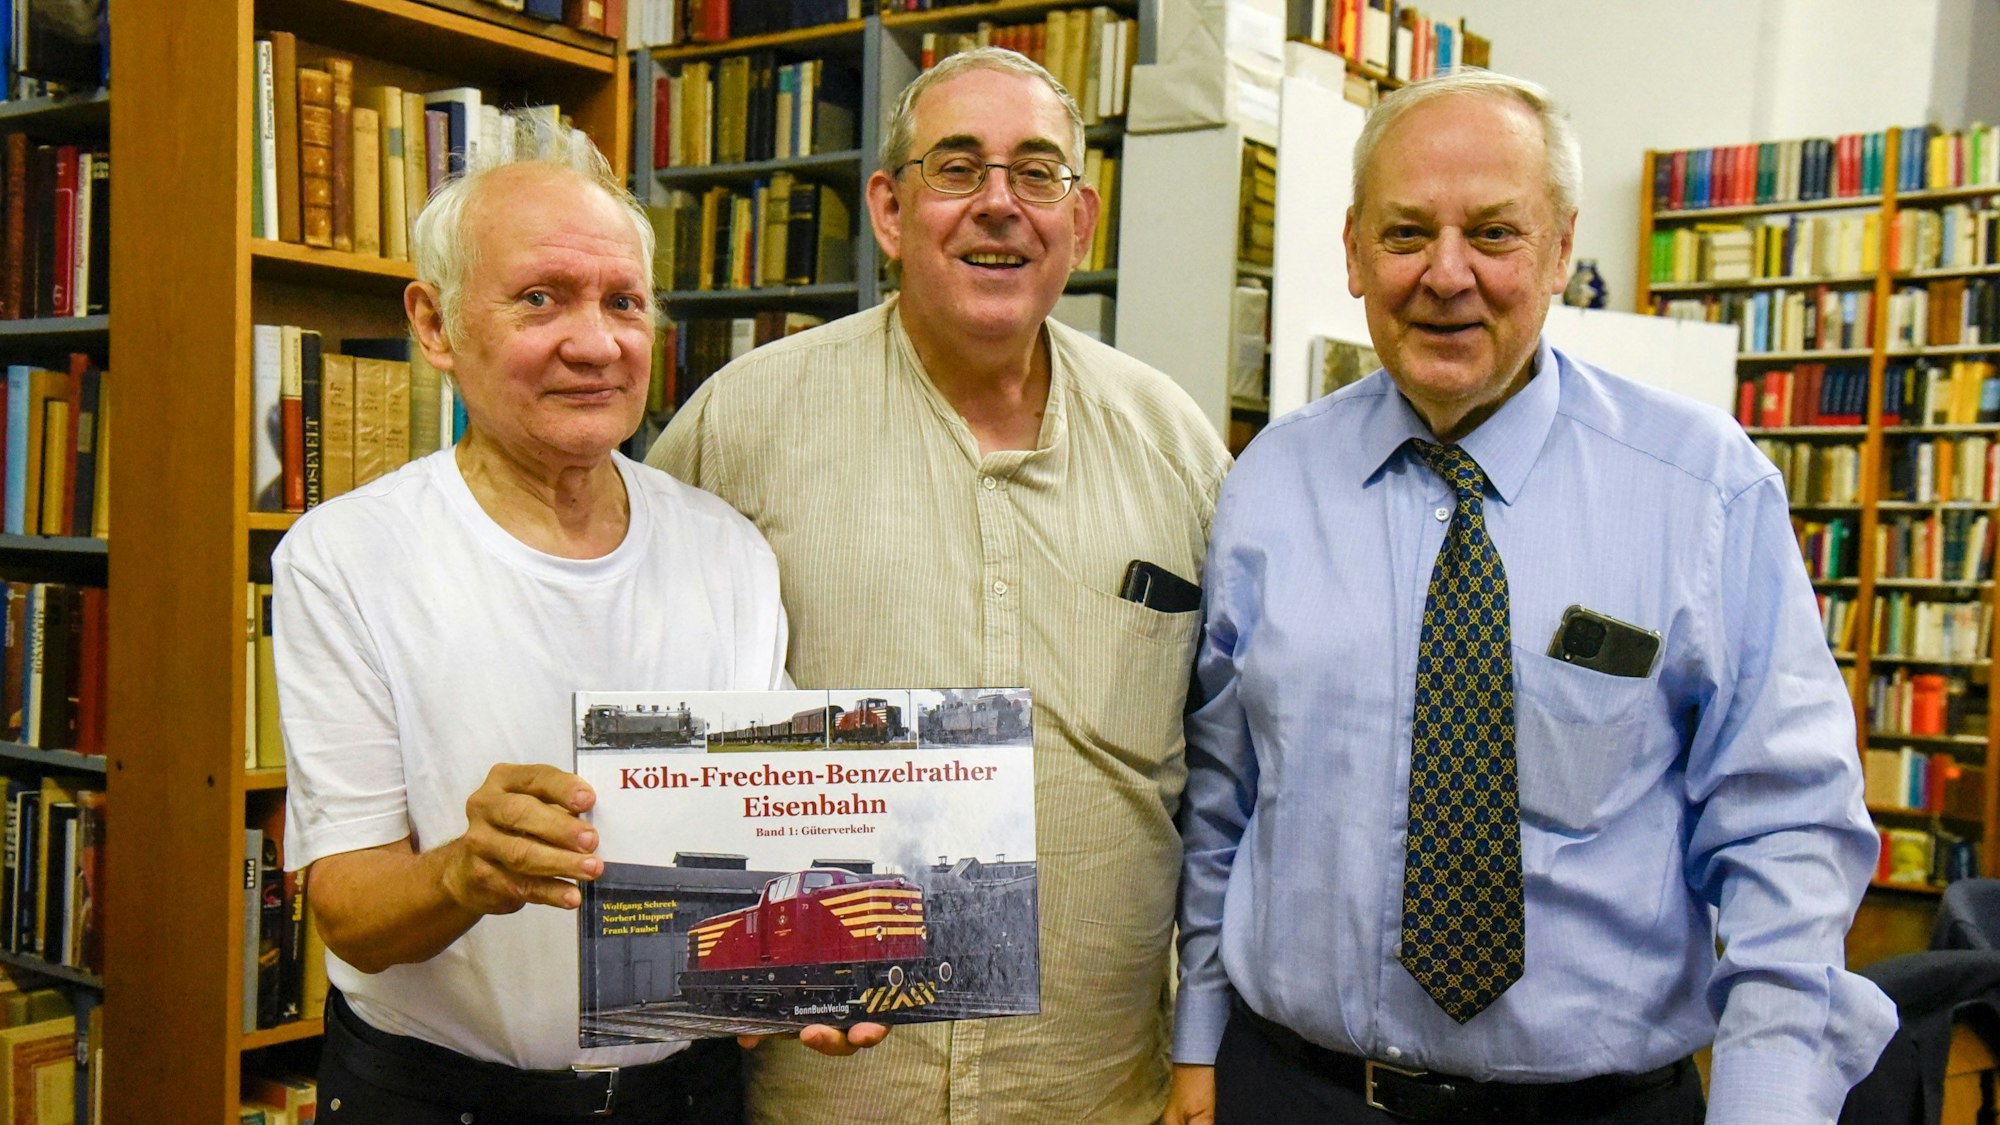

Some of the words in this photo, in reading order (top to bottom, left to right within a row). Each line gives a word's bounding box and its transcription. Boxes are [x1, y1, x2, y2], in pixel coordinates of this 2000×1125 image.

[305, 417, 320, 510] ROOSEVELT
[619, 760, 998, 790] Köln-Frechen-Benzelrather
[742, 793, 887, 818] Eisenbahn
[756, 827, 785, 837] Band
[788, 827, 798, 836] 1:
[801, 824, 876, 836] Güterverkehr
[602, 902, 643, 911] Wolfgang
[643, 900, 678, 909] Schreck
[602, 914, 636, 923] Norbert
[638, 913, 674, 922] Huppert
[602, 926, 629, 936] Frank
[630, 924, 659, 934] Faubel
[794, 1003, 850, 1016] BonnBuchVerlag
